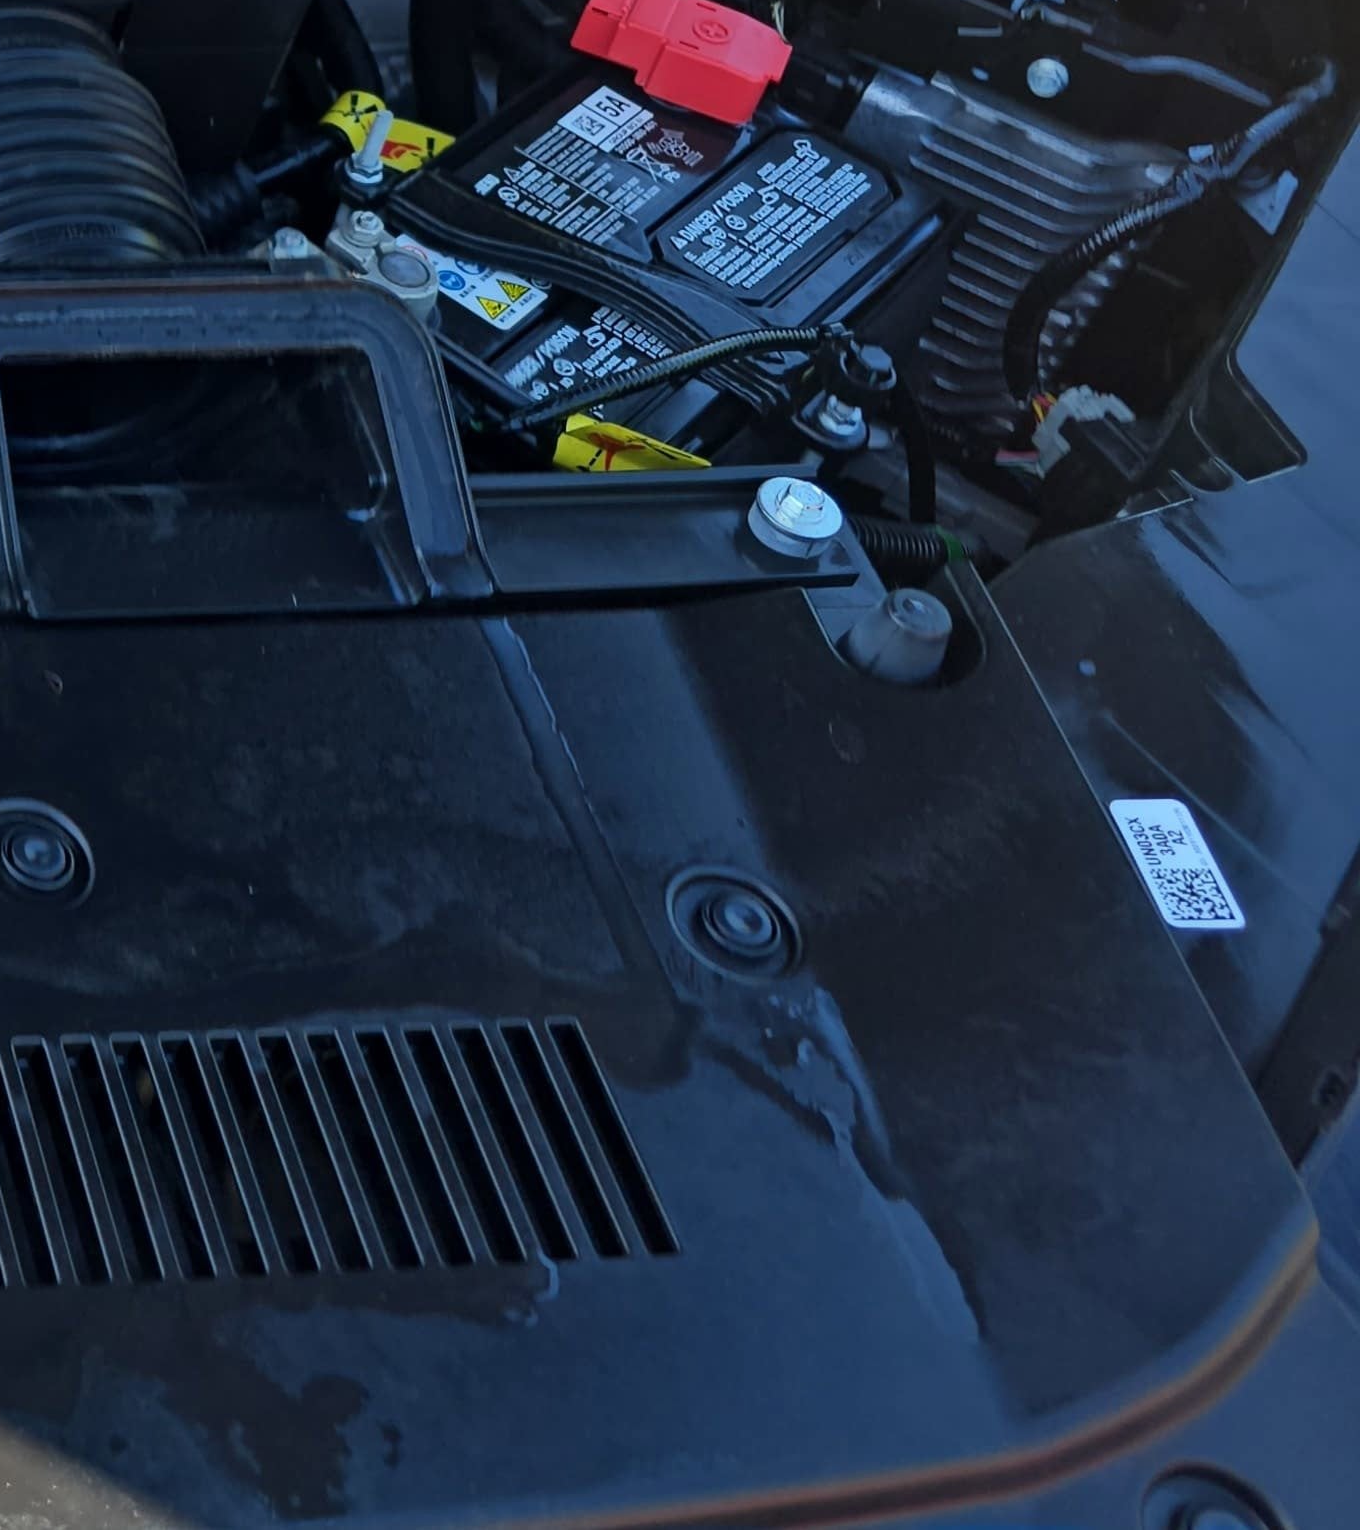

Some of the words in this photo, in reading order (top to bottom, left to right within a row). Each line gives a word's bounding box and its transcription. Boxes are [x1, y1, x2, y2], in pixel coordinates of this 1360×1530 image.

[595, 95, 631, 118] 5A
[682, 209, 720, 242] DANGER
[716, 181, 755, 212] POISON
[1125, 817, 1162, 866] UN03CX
[1148, 824, 1176, 856] 3A0A
[1167, 830, 1188, 846] A2
